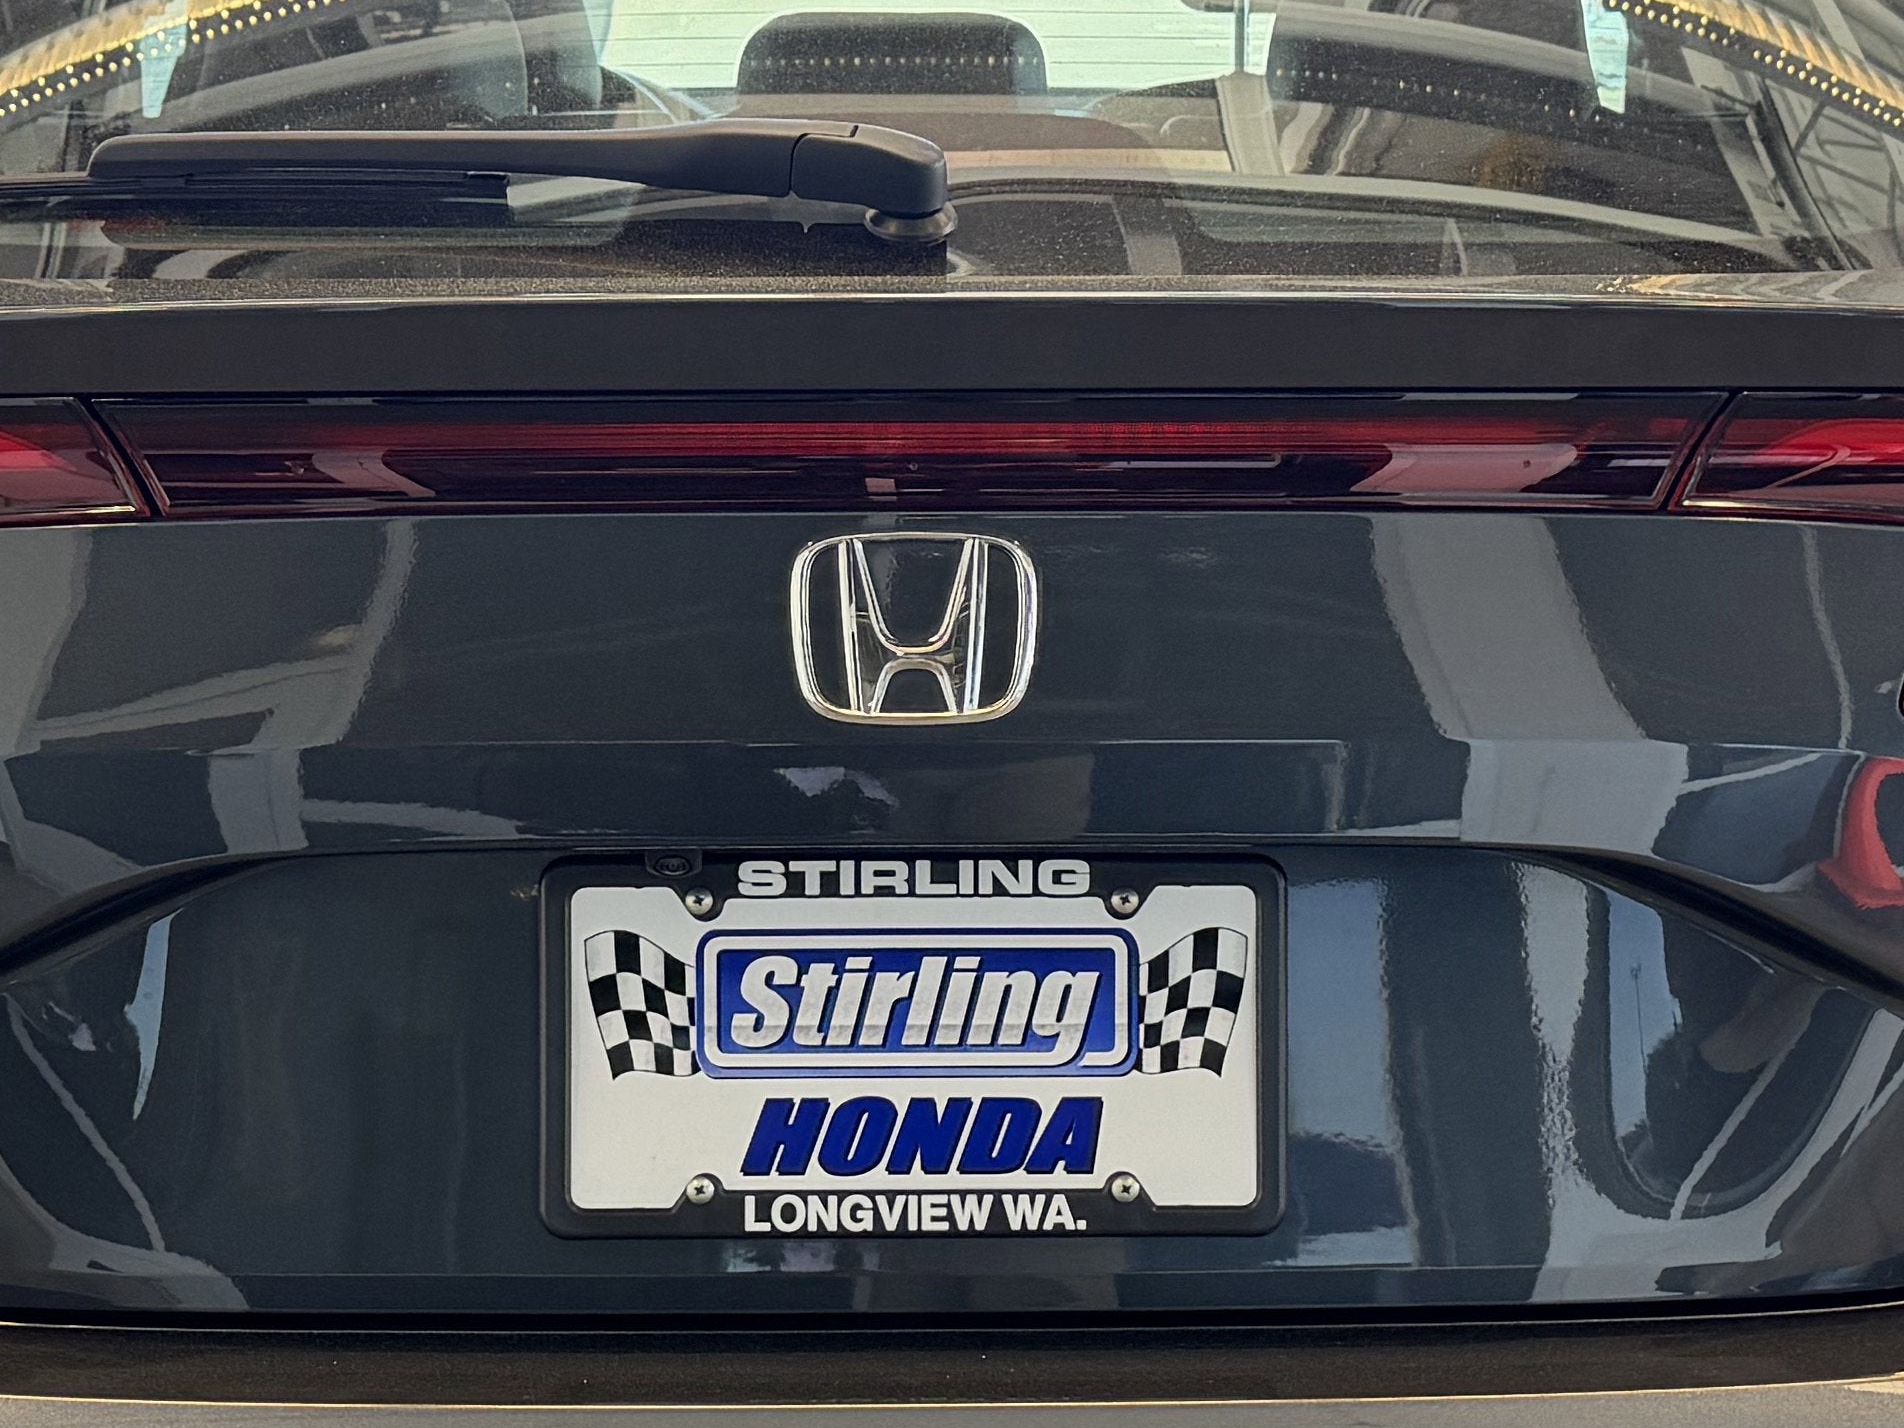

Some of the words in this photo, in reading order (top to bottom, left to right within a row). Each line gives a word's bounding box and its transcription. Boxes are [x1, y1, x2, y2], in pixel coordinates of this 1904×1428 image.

[736, 859, 1092, 896] STIRLING
[729, 953, 1102, 1062] Stirling
[739, 1095, 1105, 1177] HONDA
[743, 1193, 995, 1234] LONGVIEW
[1000, 1193, 1088, 1232] WA.
